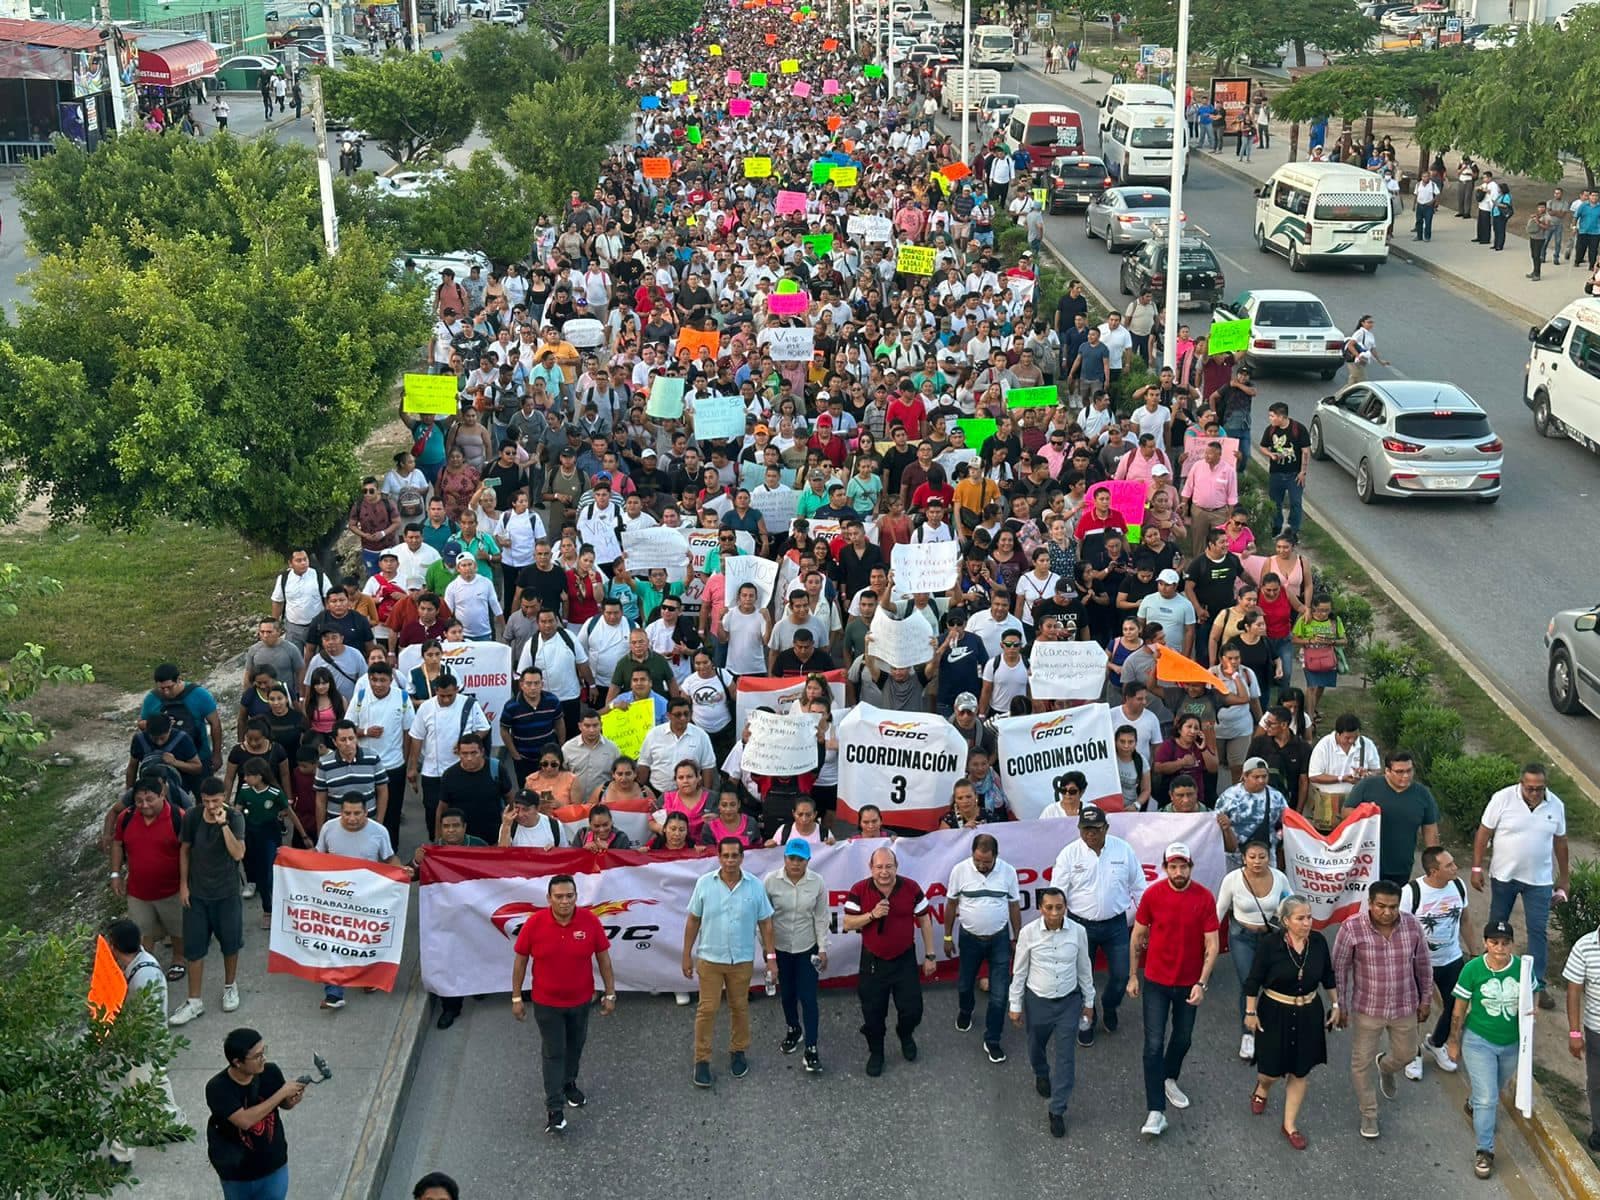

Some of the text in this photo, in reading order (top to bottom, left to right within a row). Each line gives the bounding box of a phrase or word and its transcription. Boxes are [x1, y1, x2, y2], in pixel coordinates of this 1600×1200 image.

[692, 539, 720, 547] CRO
[1056, 613, 1077, 621] UCCI
[440, 657, 475, 665] ROC
[464, 673, 508, 688] JADORES
[846, 744, 958, 772] COORDINACIÓN
[1007, 737, 1109, 777] COORDINACIÓN
[890, 775, 908, 804] 3
[1296, 853, 1310, 863] LOS
[289, 893, 389, 916] LOS TRABAJADORES
[1307, 894, 1322, 904] DE
[287, 906, 391, 932] MERECEMOS
[292, 920, 382, 945] JORNADAS
[295, 936, 377, 958] DE 40 HORAS
